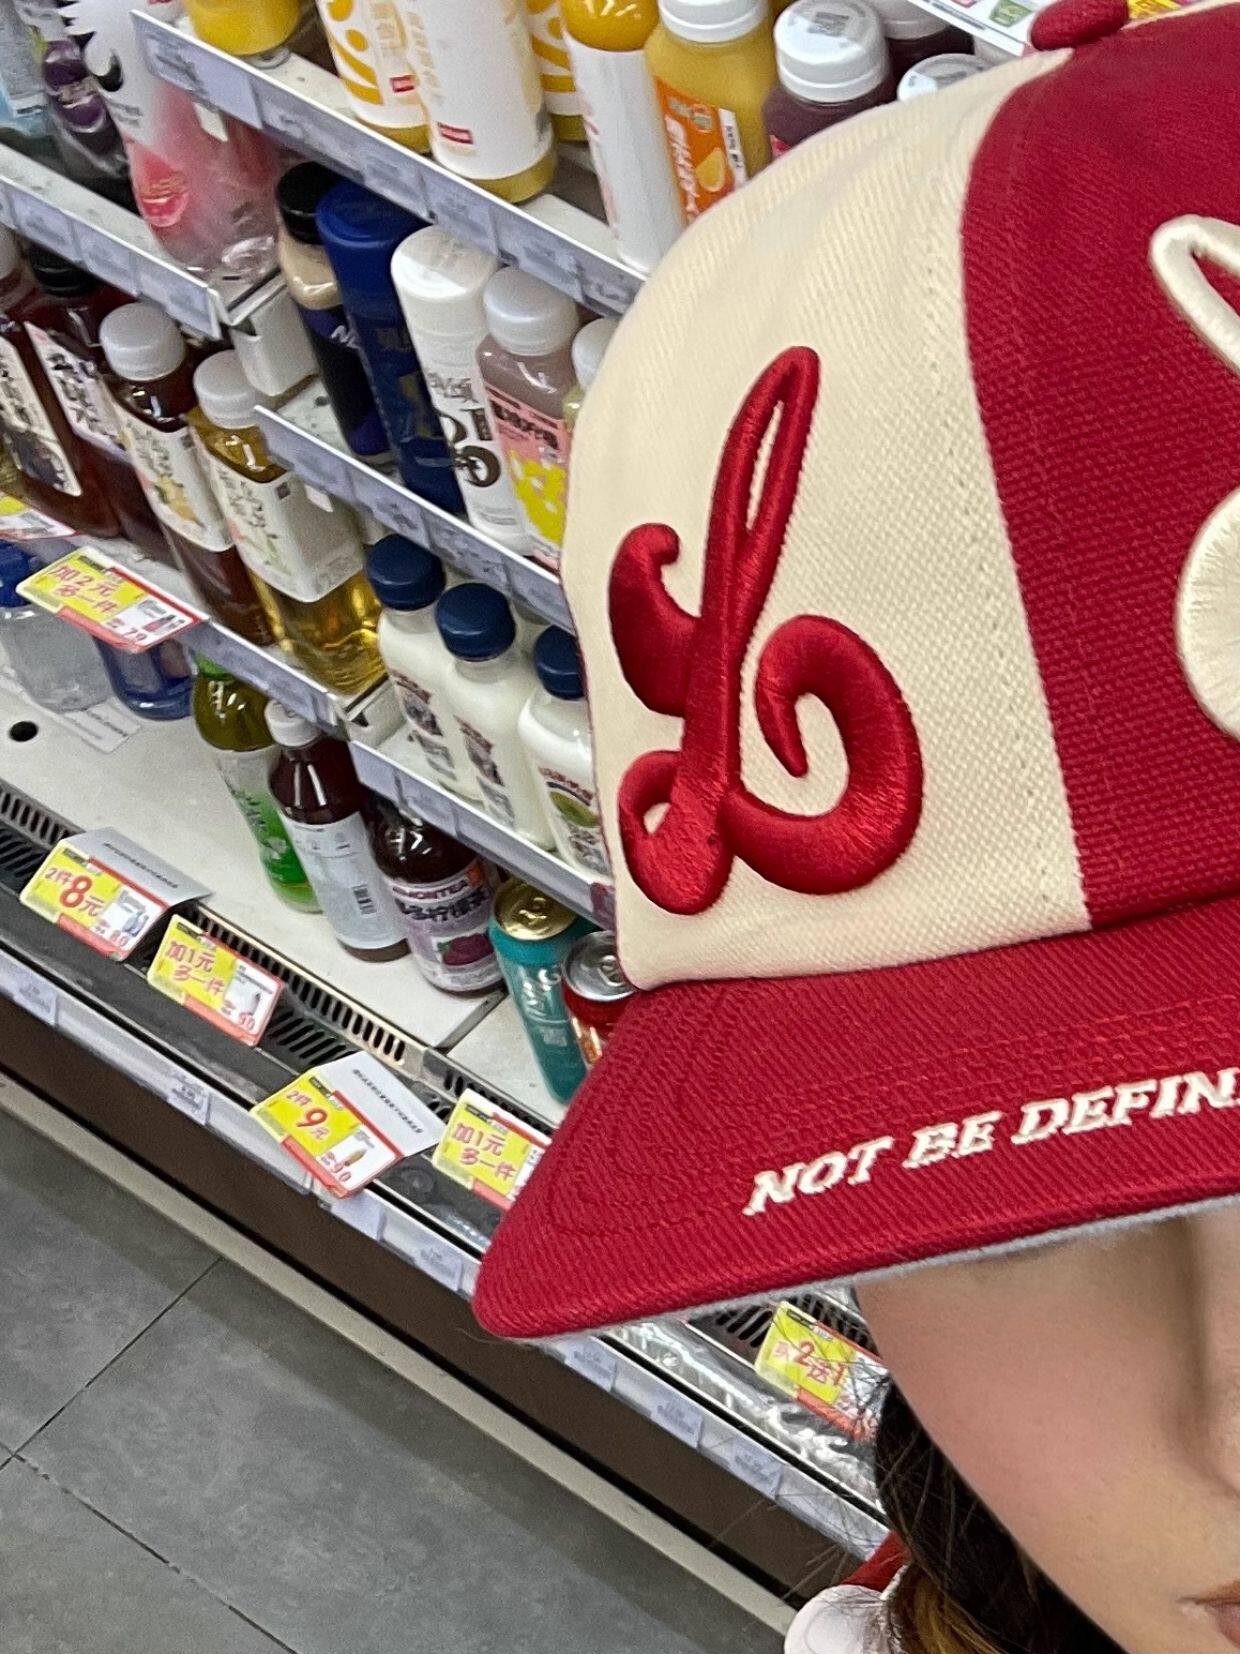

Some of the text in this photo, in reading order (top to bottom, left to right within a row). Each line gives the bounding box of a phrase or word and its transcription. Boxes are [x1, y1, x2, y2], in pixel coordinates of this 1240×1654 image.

[166, 939, 217, 974] 加1元
[173, 965, 226, 996] 多一件
[454, 1122, 507, 1157] 加1元
[460, 1148, 517, 1181] 多一件
[742, 1135, 895, 1217] NOT
[902, 1109, 1003, 1169] BE
